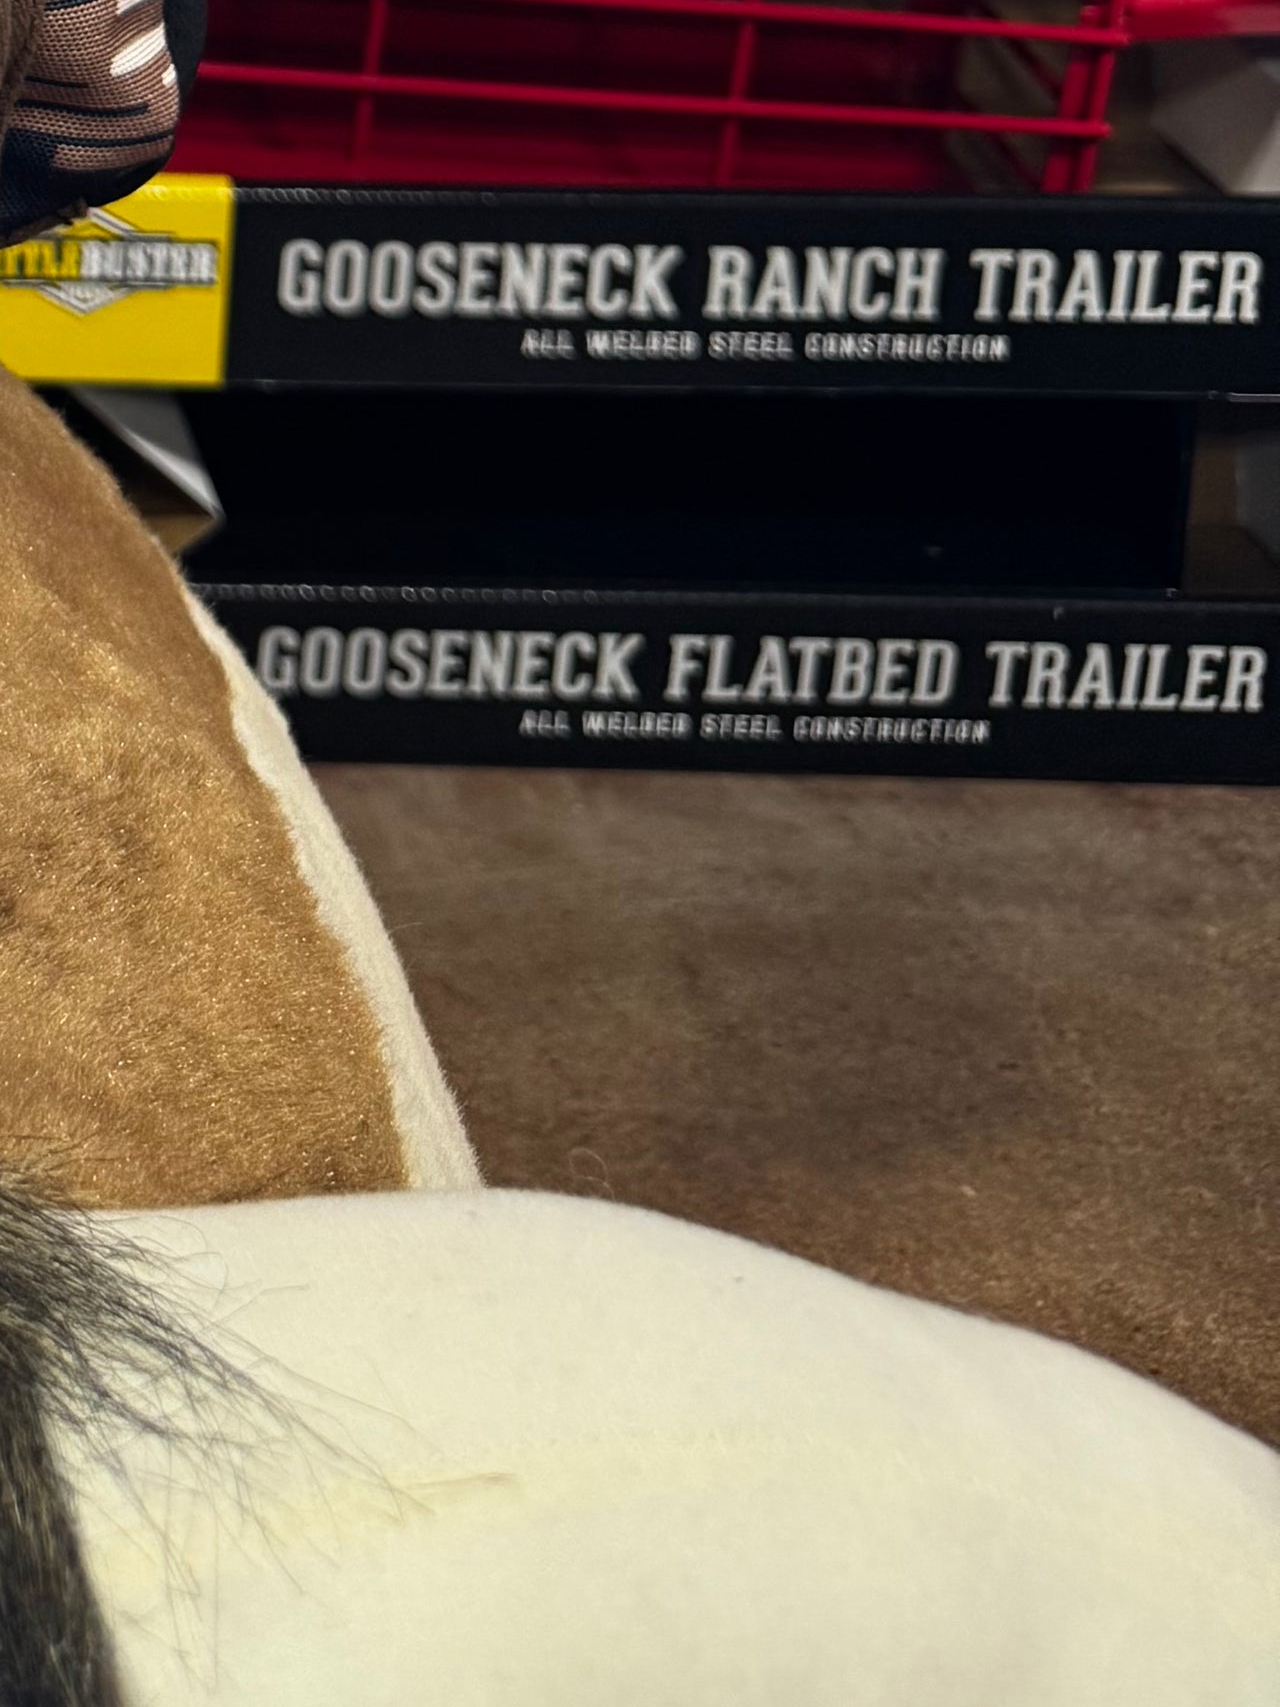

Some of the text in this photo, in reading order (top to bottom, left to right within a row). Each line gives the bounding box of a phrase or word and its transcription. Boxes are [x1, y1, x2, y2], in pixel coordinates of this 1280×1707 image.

[276, 237, 1265, 325] GOOSENECK RANCH TRAILER
[520, 327, 1012, 364] ALL WELDED STEEL CONSTRUCTION
[254, 624, 1269, 714] GOOSENECK FLATBED TRAILER
[518, 708, 992, 745] ALL WELDED STEEL CONSTRUCTION
